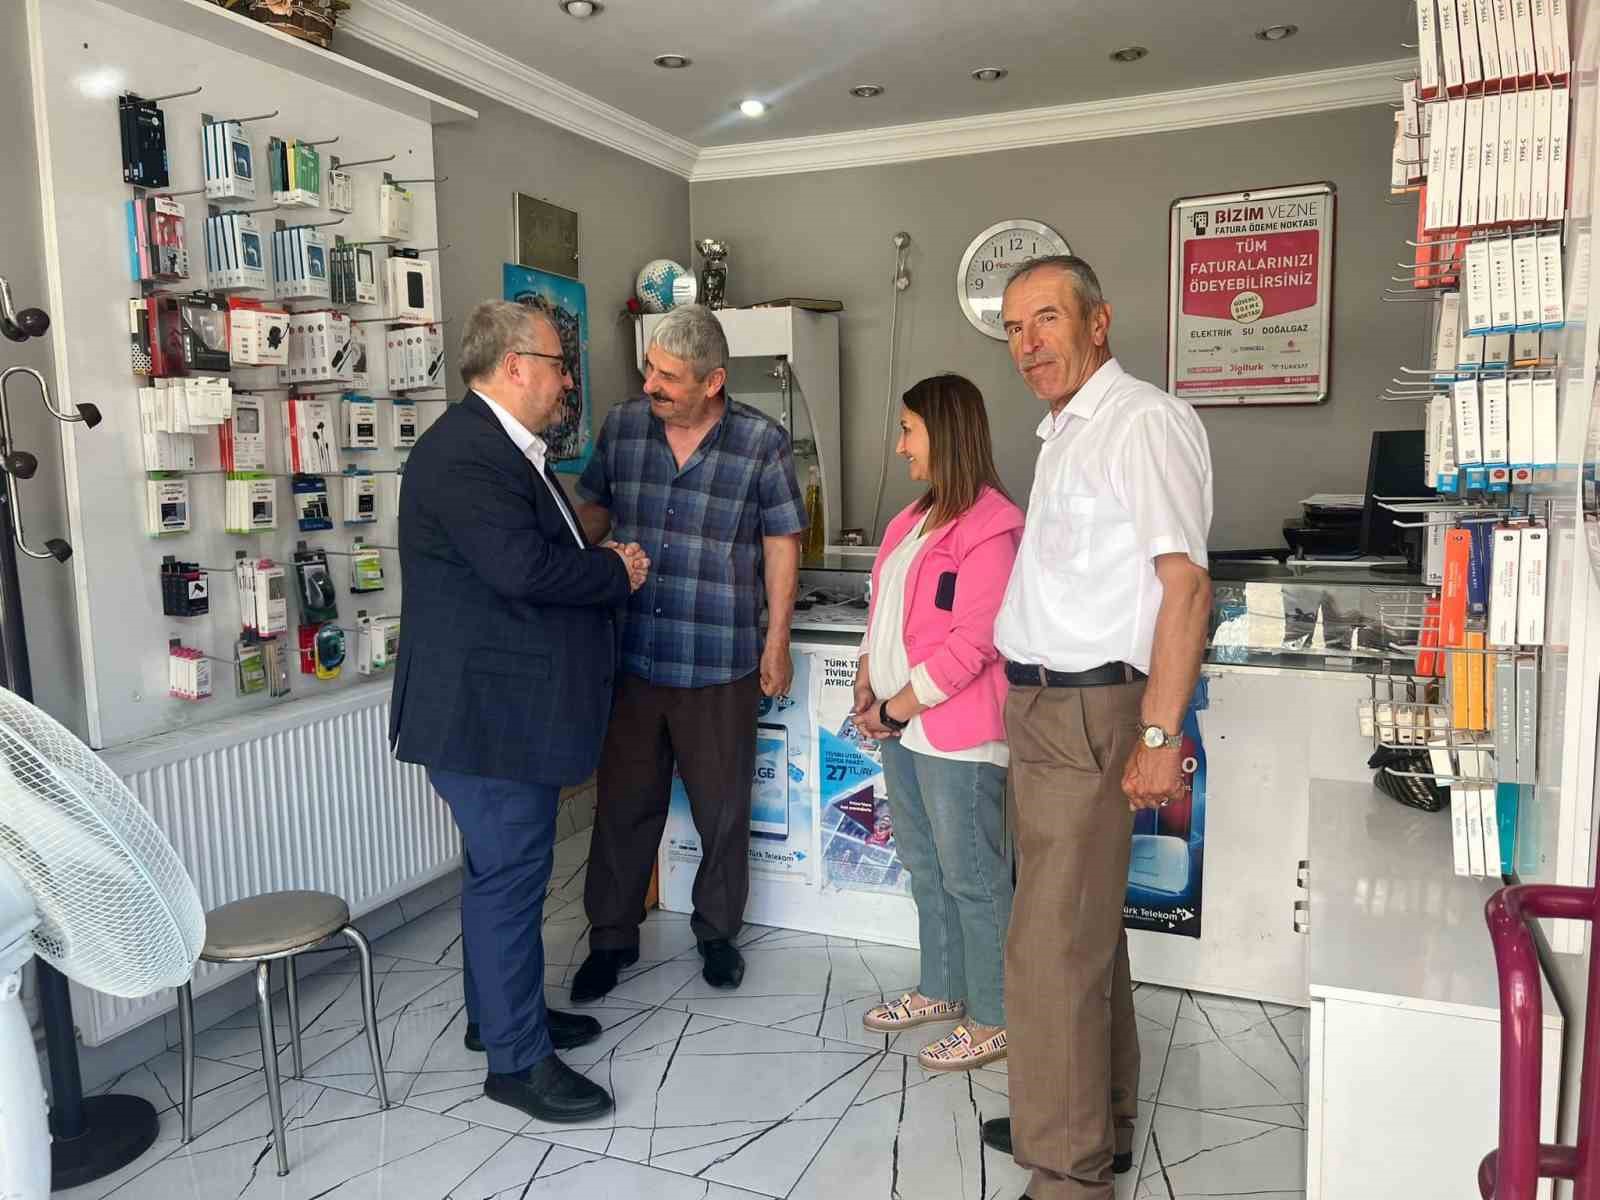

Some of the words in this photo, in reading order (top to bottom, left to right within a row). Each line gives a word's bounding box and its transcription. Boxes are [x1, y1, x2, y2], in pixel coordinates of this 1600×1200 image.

[1215, 206, 1264, 224] BİZİM
[1268, 202, 1317, 219] VEZNE
[1215, 224, 1247, 234] FATURA
[1249, 221, 1278, 232] ÖDEME
[1280, 218, 1318, 230] NOKTASI
[1009, 238, 1023, 251] 12
[1032, 242, 1037, 254] 1
[1236, 238, 1267, 253] TÜM
[994, 246, 1003, 258] 11
[981, 261, 994, 272] 10
[1190, 254, 1313, 275] FATURALARINIZI
[975, 279, 984, 290] 9
[1189, 273, 1313, 293] ÖDEYEBİLİRSİNİZ
[1190, 328, 1232, 339] ELEKTRİK
[1242, 328, 1254, 336] SU
[1262, 324, 1308, 335] DOĞALGAZ
[824, 657, 848, 668] TÜRK
[825, 668, 854, 678] TİVİBU
[826, 765, 847, 781] 27
[765, 851, 794, 861] Telekom
[1141, 908, 1178, 921] Telekom
